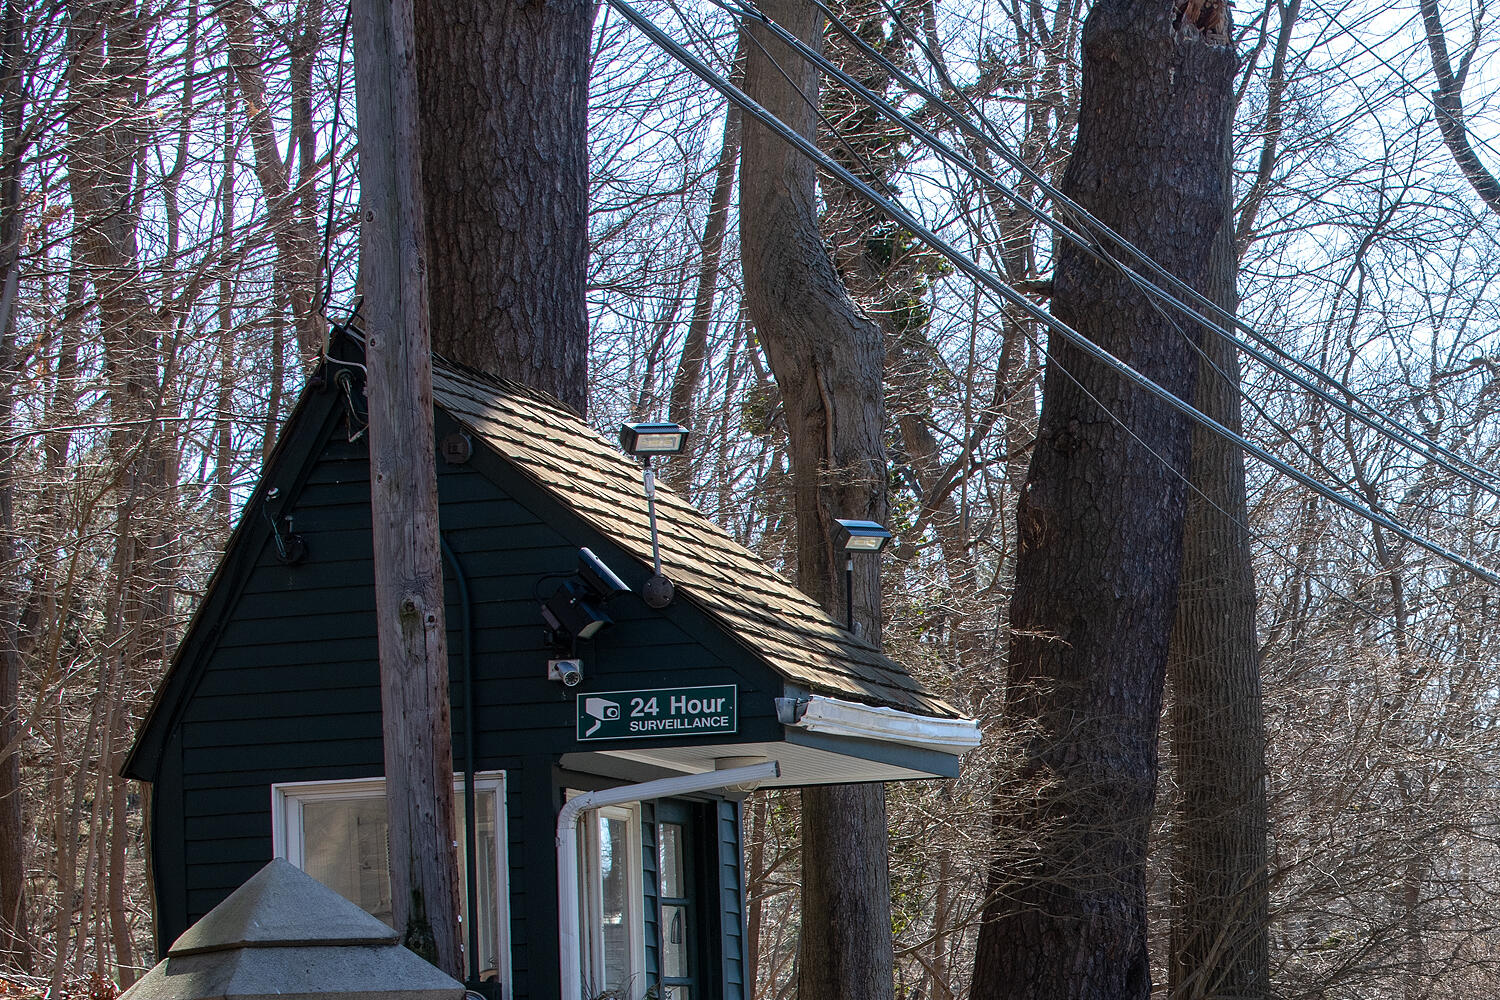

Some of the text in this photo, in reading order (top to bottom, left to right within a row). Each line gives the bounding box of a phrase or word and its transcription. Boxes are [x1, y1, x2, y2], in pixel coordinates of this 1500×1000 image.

[630, 695, 726, 716] 24 Hour
[629, 715, 729, 732] SURVEILLANCE
